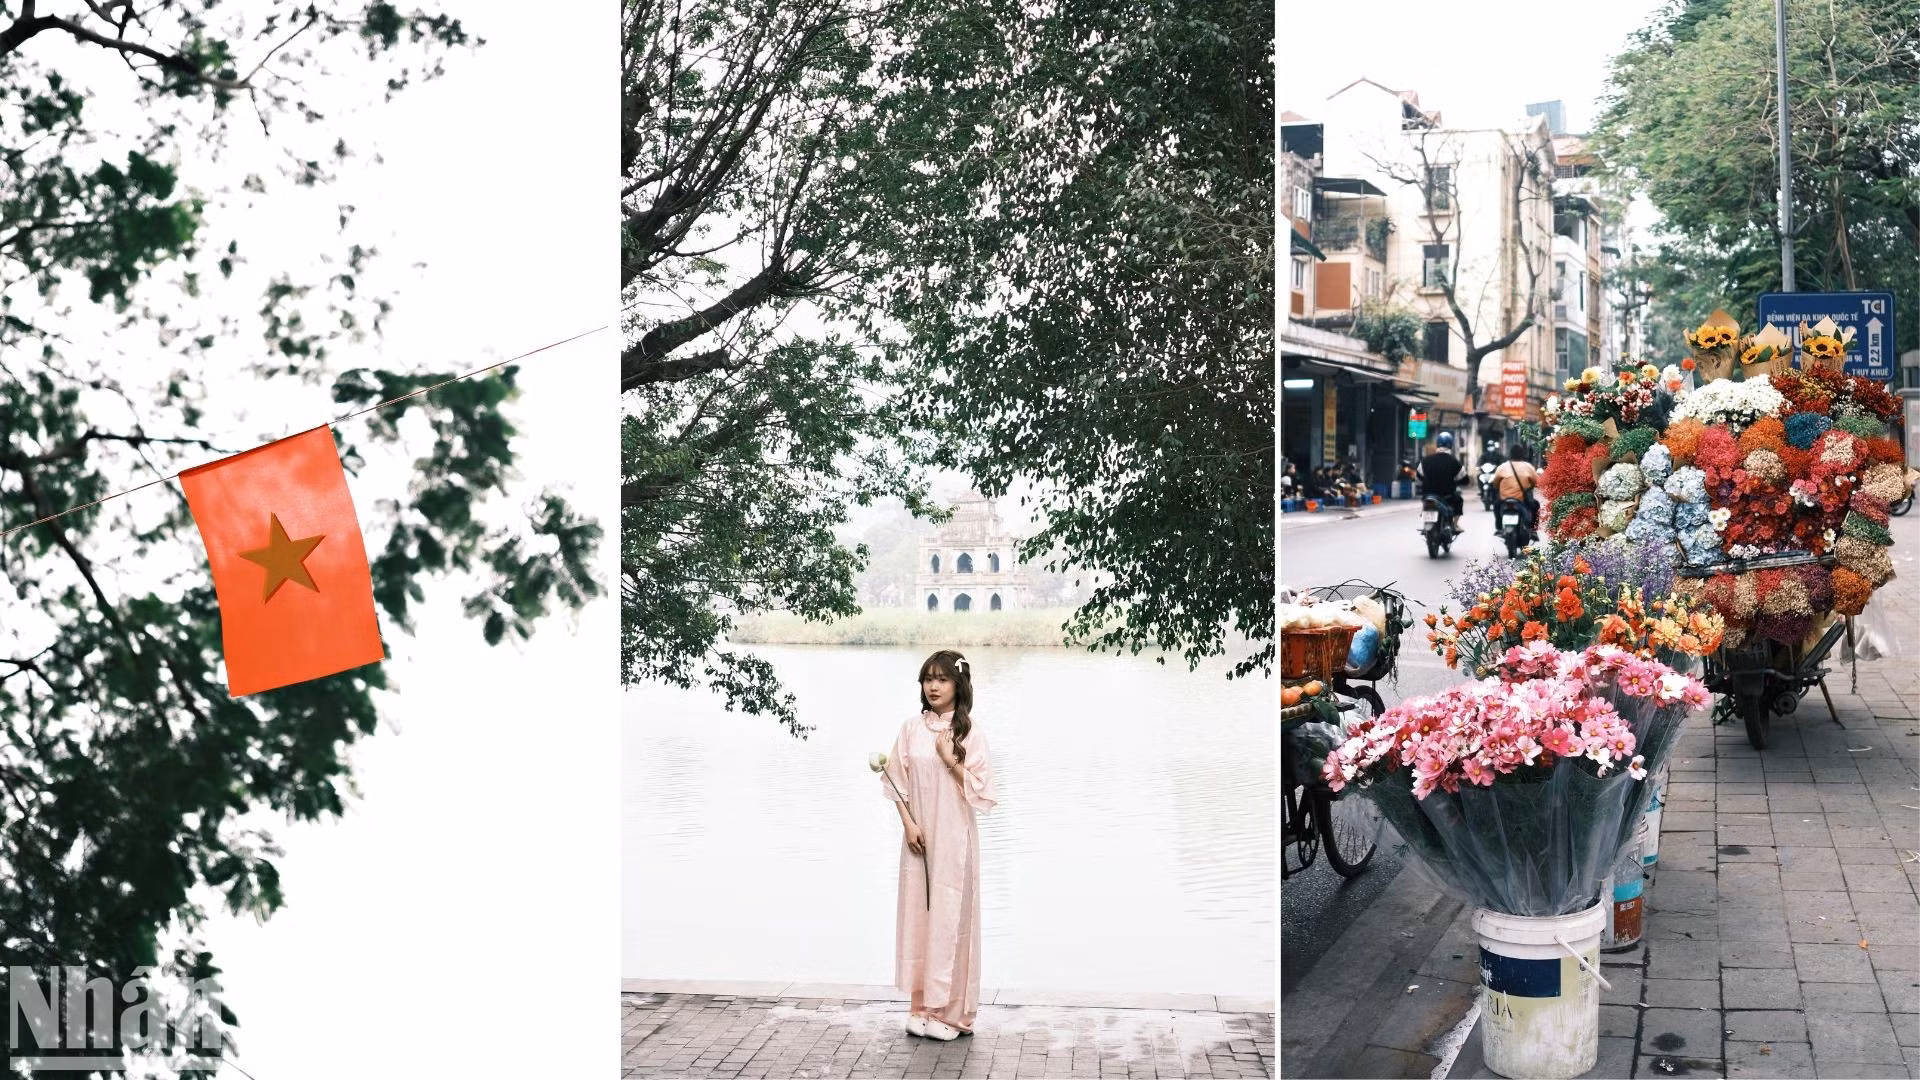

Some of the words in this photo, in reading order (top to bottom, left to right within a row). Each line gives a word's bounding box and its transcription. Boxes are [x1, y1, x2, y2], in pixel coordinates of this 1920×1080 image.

[1862, 299, 1885, 314] TCI
[1870, 333, 1880, 347] km
[1503, 362, 1525, 371] PRINT
[1503, 374, 1525, 383] PHOTO
[1504, 385, 1523, 395] COPY
[1504, 397, 1524, 407] SCAN
